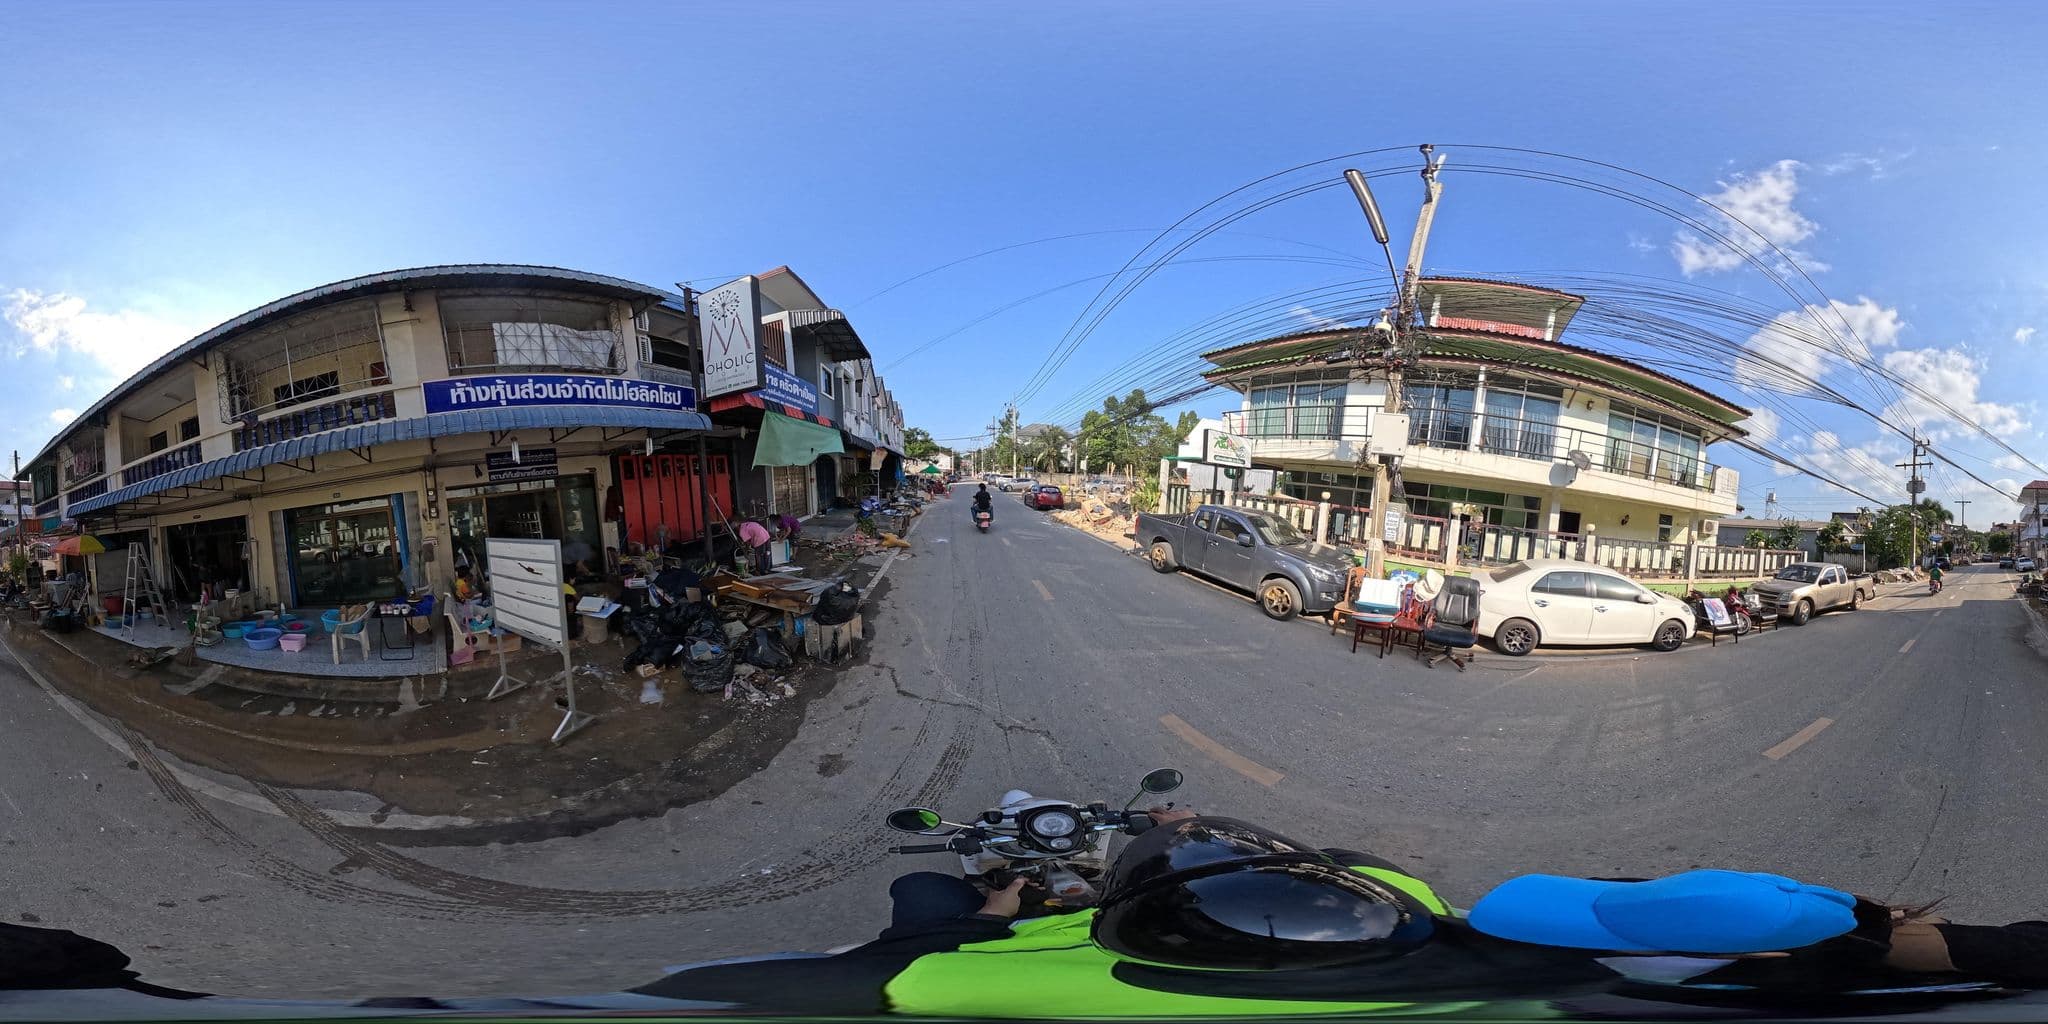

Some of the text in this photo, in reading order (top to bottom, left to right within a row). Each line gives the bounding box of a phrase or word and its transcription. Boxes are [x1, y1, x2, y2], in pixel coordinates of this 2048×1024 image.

[706, 352, 755, 375] OHOLIC
[450, 378, 681, 406] ห้างหุ้นส่วนจำกัดโมโฮลิคโชป
